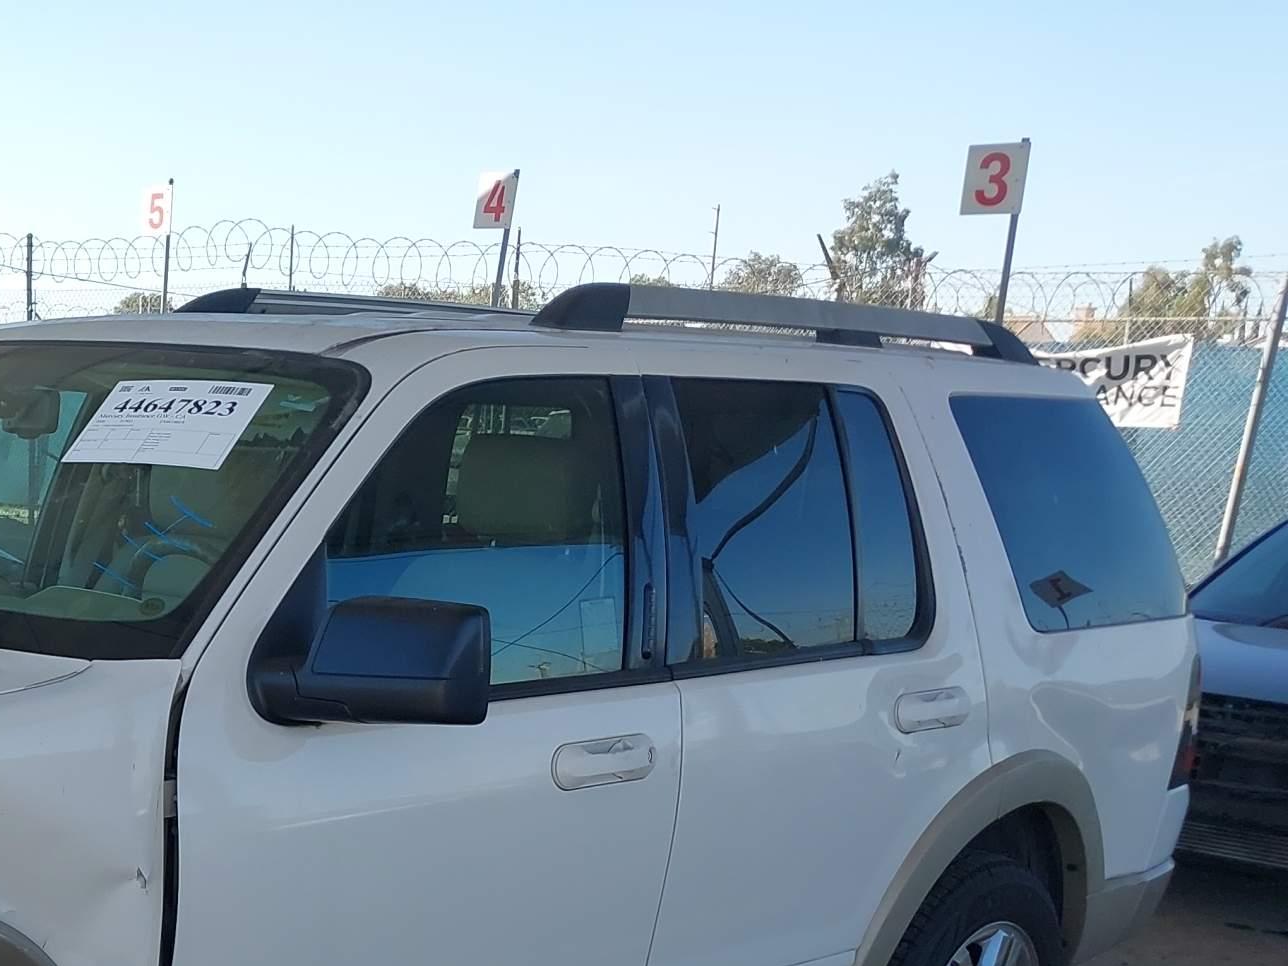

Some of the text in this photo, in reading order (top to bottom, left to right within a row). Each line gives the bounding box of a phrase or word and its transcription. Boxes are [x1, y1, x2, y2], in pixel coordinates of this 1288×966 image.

[975, 151, 1011, 207] 3
[148, 192, 164, 229] 5
[483, 179, 505, 222] 4
[1036, 354, 1184, 380] RCURY
[114, 398, 238, 417] 44647823
